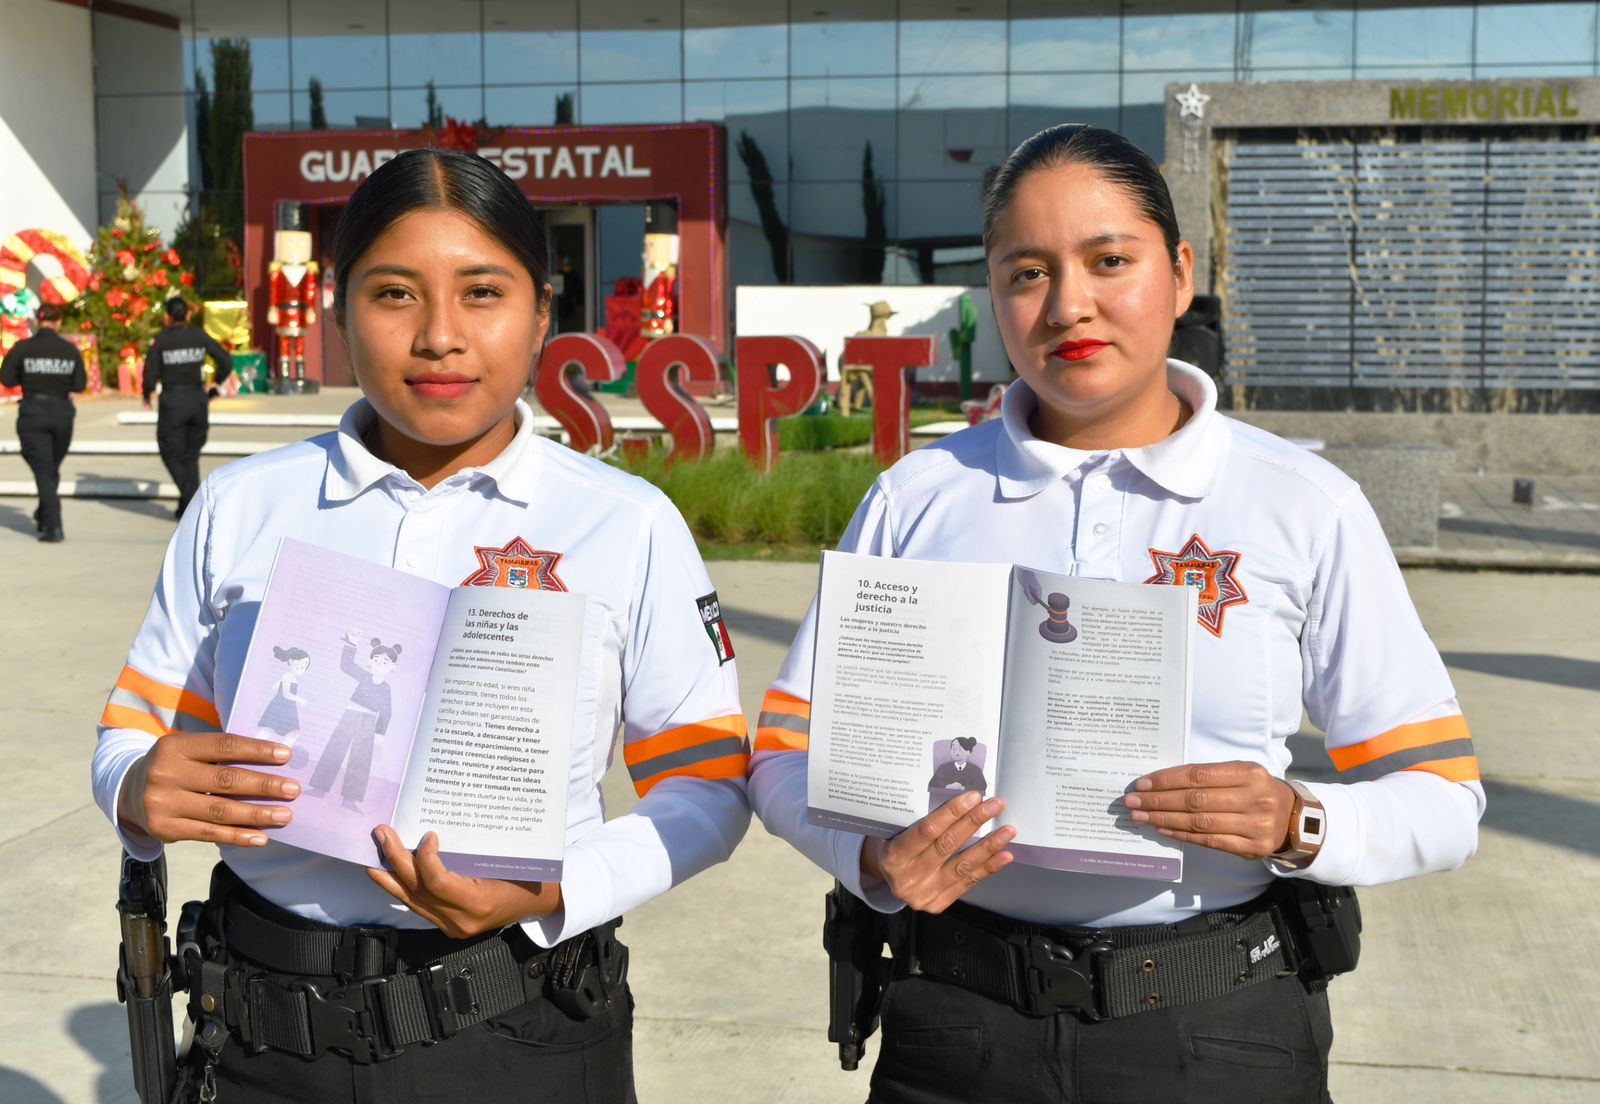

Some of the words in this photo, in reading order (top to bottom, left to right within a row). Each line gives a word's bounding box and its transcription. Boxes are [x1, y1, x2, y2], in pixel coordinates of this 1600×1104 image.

[1390, 84, 1578, 119] MEMORIAL
[858, 578, 872, 589] 10.
[874, 580, 909, 592] Acceso
[912, 586, 918, 595] y
[856, 591, 897, 602] derecho
[909, 595, 918, 604] la
[468, 607, 477, 616] 13.
[479, 608, 516, 619] Derechos
[517, 611, 528, 620] de
[855, 603, 892, 614] justicia
[465, 619, 475, 628] las
[477, 620, 498, 629] niñas
[500, 623, 505, 631] y
[506, 622, 519, 630] las
[463, 630, 514, 642] adolescentes
[451, 730, 475, 738] escuela,
[482, 732, 516, 741] descansar
[433, 738, 464, 746] momentos
[474, 742, 522, 753] esparcimiento,
[530, 747, 549, 755] tener
[429, 758, 460, 767] culturales,
[441, 749, 464, 757] propias
[497, 754, 529, 763] religiosas
[426, 777, 460, 786] libremente
[485, 782, 510, 791] tomada
[472, 772, 509, 781] manifestar
[523, 776, 541, 784] ideas
